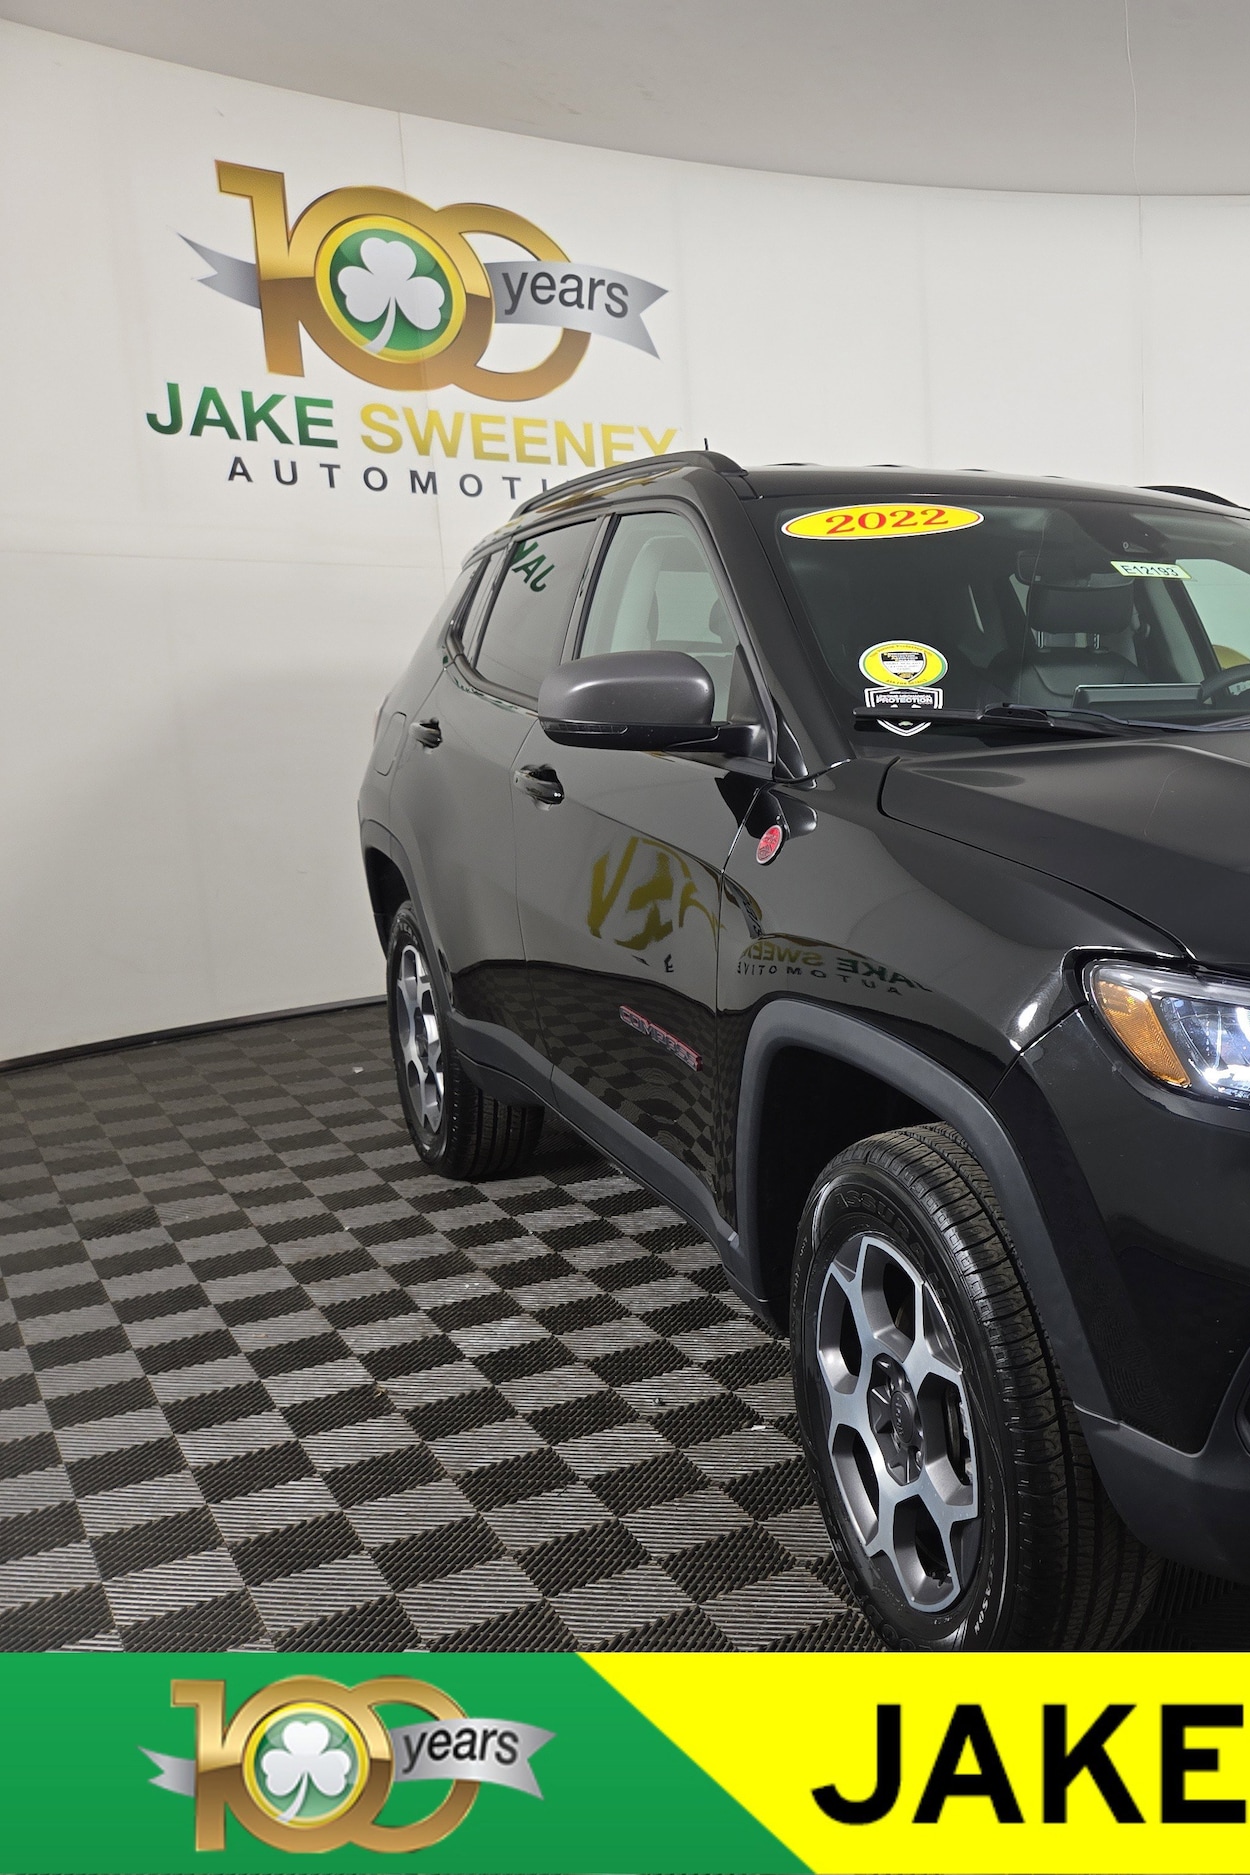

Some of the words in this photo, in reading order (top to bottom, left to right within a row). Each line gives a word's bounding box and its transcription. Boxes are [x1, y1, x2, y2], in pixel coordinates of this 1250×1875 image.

[501, 269, 630, 319] years
[146, 382, 339, 449] JAKE
[360, 403, 678, 469] SWEENEY
[826, 509, 948, 535] 2022
[1120, 565, 1179, 576] E12193
